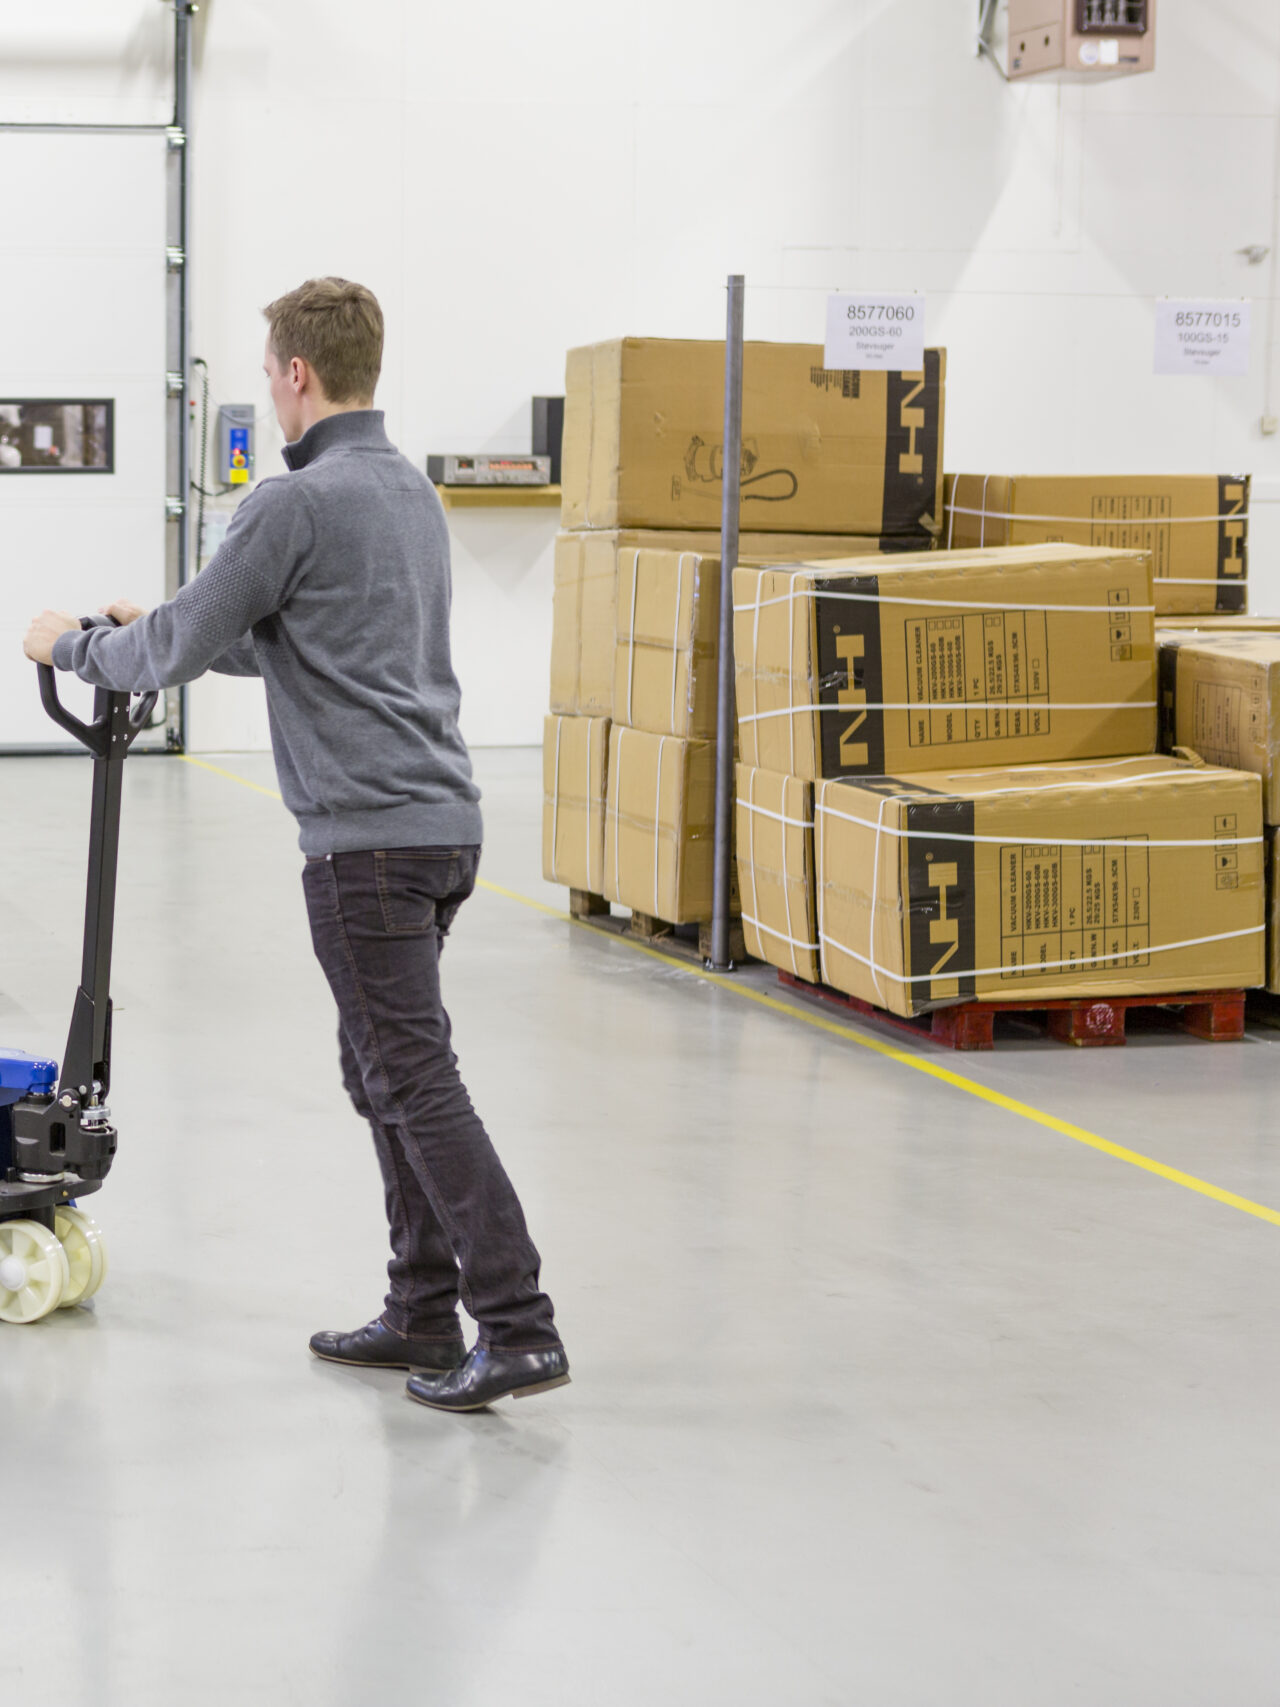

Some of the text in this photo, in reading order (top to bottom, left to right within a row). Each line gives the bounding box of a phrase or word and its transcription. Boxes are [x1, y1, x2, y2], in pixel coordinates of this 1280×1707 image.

[847, 305, 915, 321] 8577060
[1176, 312, 1241, 328] 8577015
[848, 326, 902, 337] 200GS-60
[1178, 333, 1229, 344] 100GS-15
[973, 678, 979, 689] PC
[1069, 907, 1075, 919] PC
